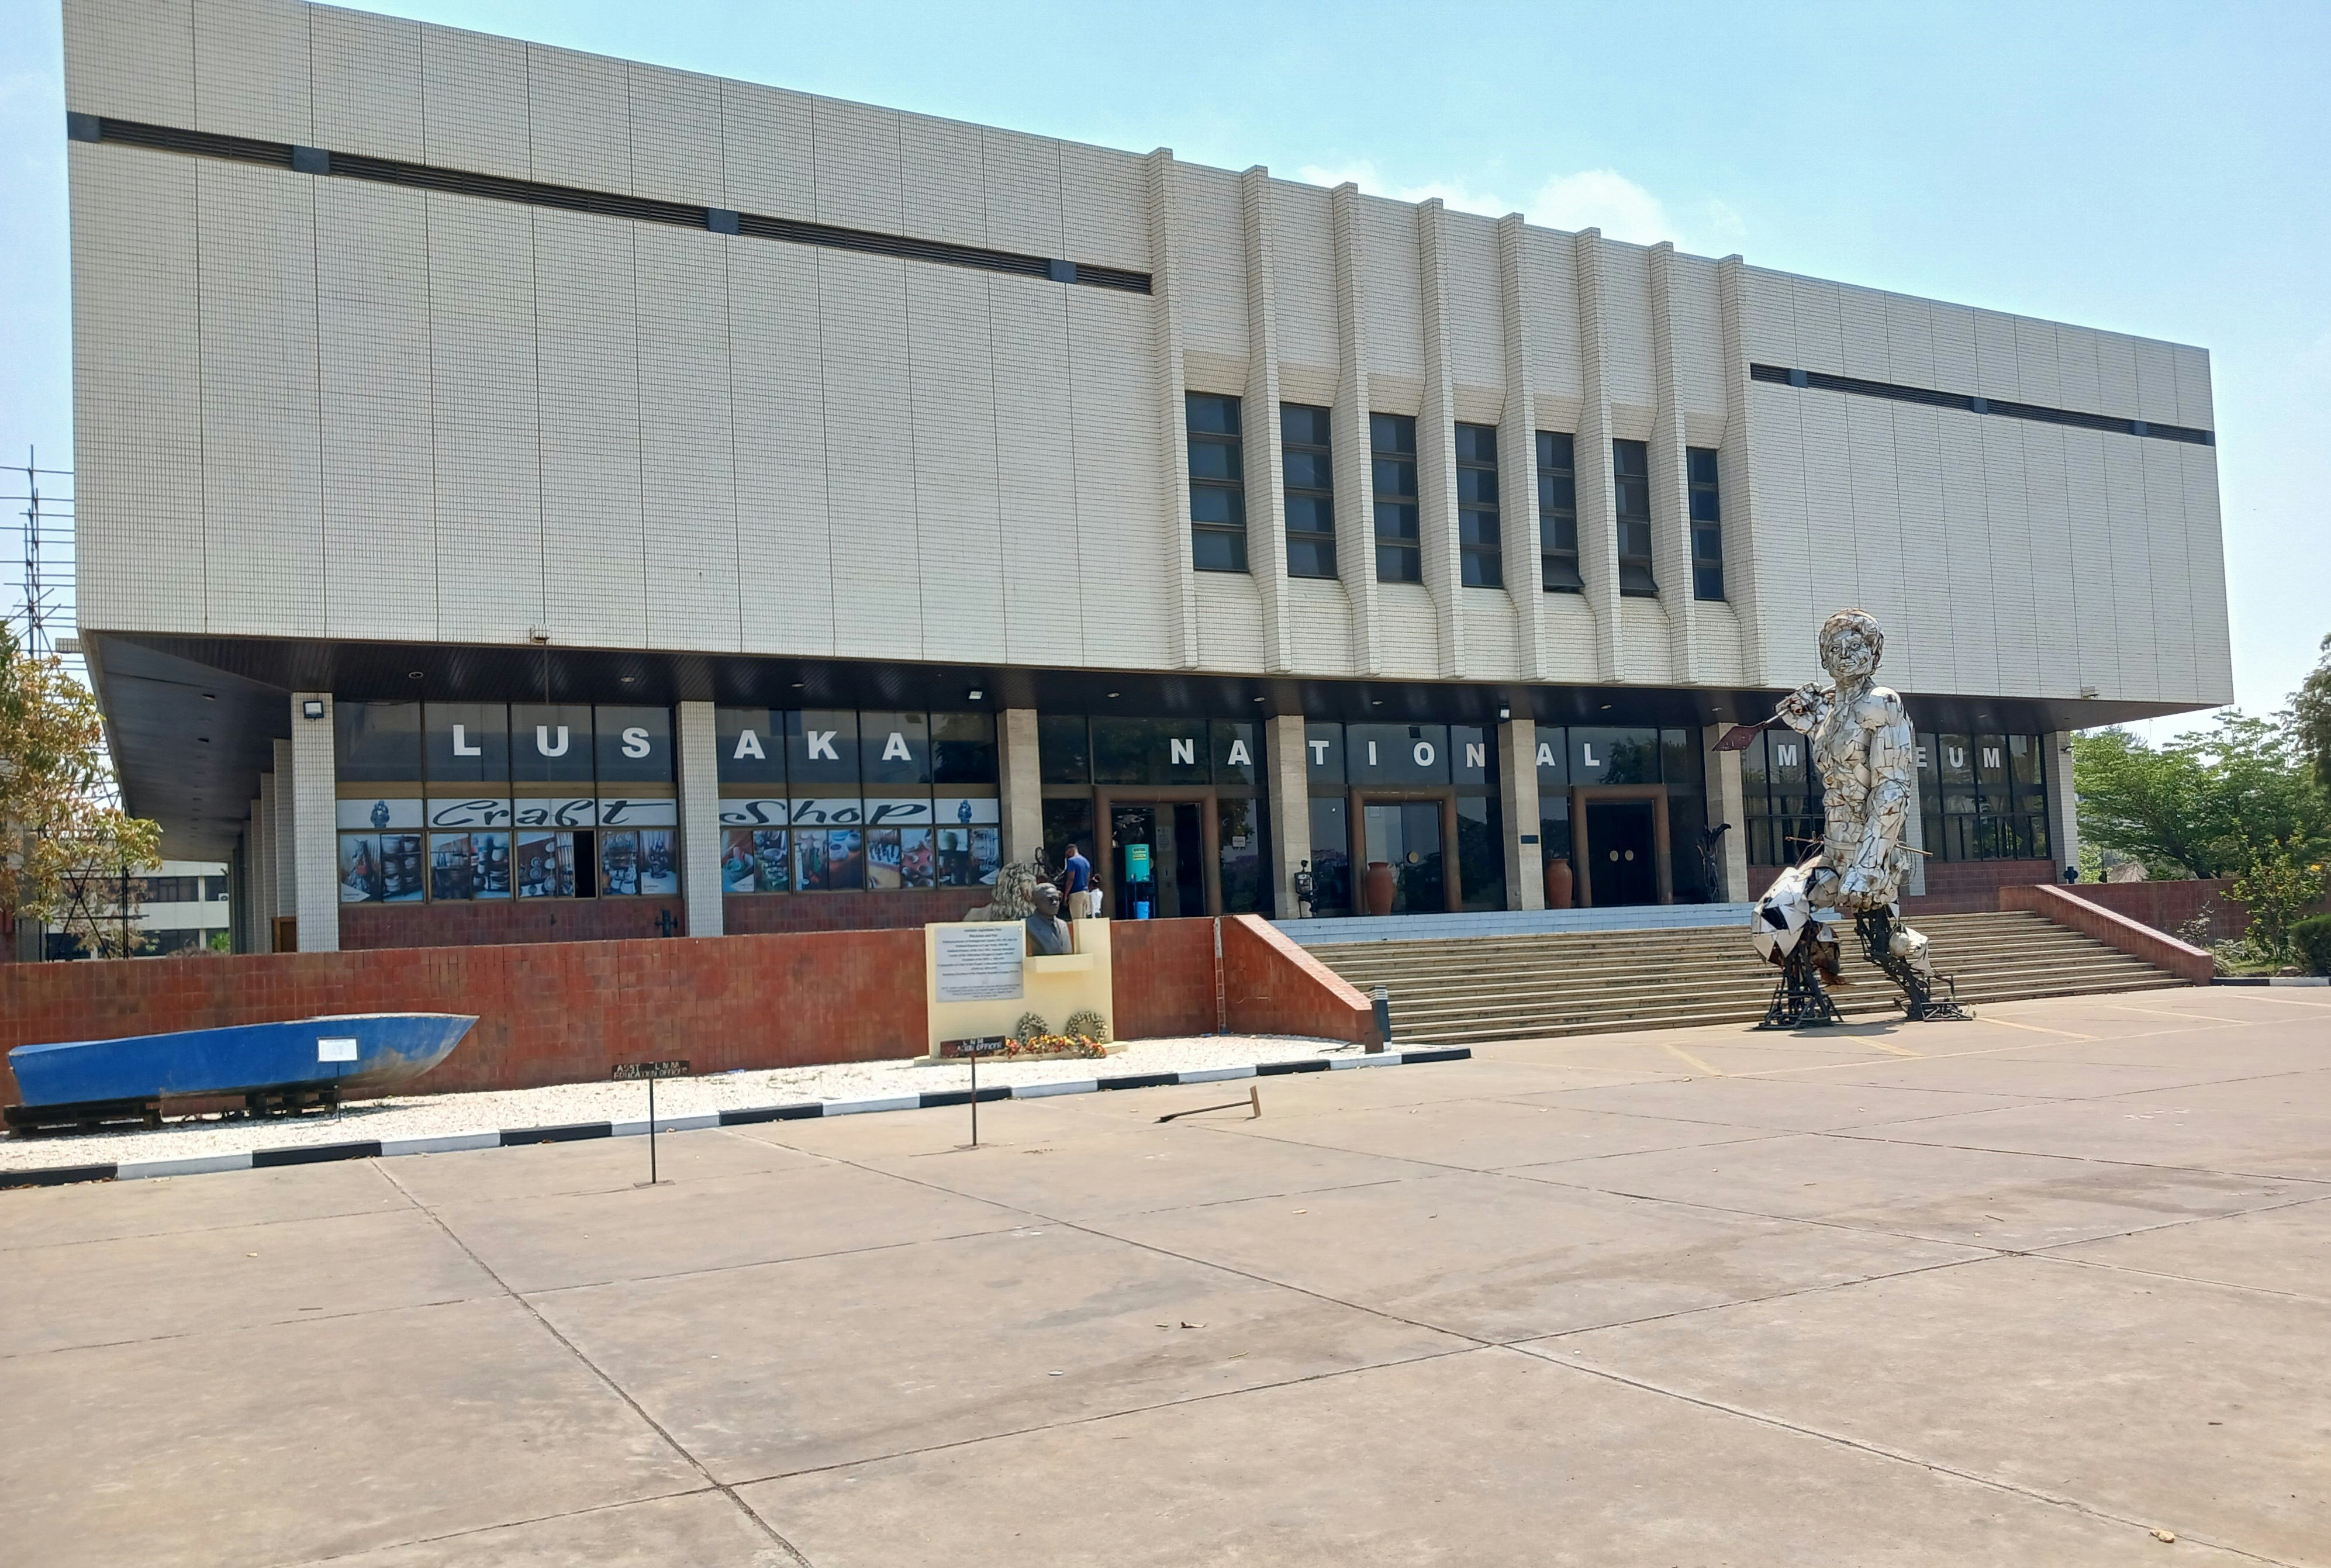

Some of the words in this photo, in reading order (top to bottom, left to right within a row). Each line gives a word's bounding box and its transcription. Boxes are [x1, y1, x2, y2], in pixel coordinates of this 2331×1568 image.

[453, 724, 912, 761] LUSAKA
[1170, 738, 1601, 768] NATIONAL
[1777, 744, 2001, 768] MEUM
[433, 799, 674, 827] Craft
[720, 800, 928, 824] Shop
[617, 1063, 641, 1072] ASST
